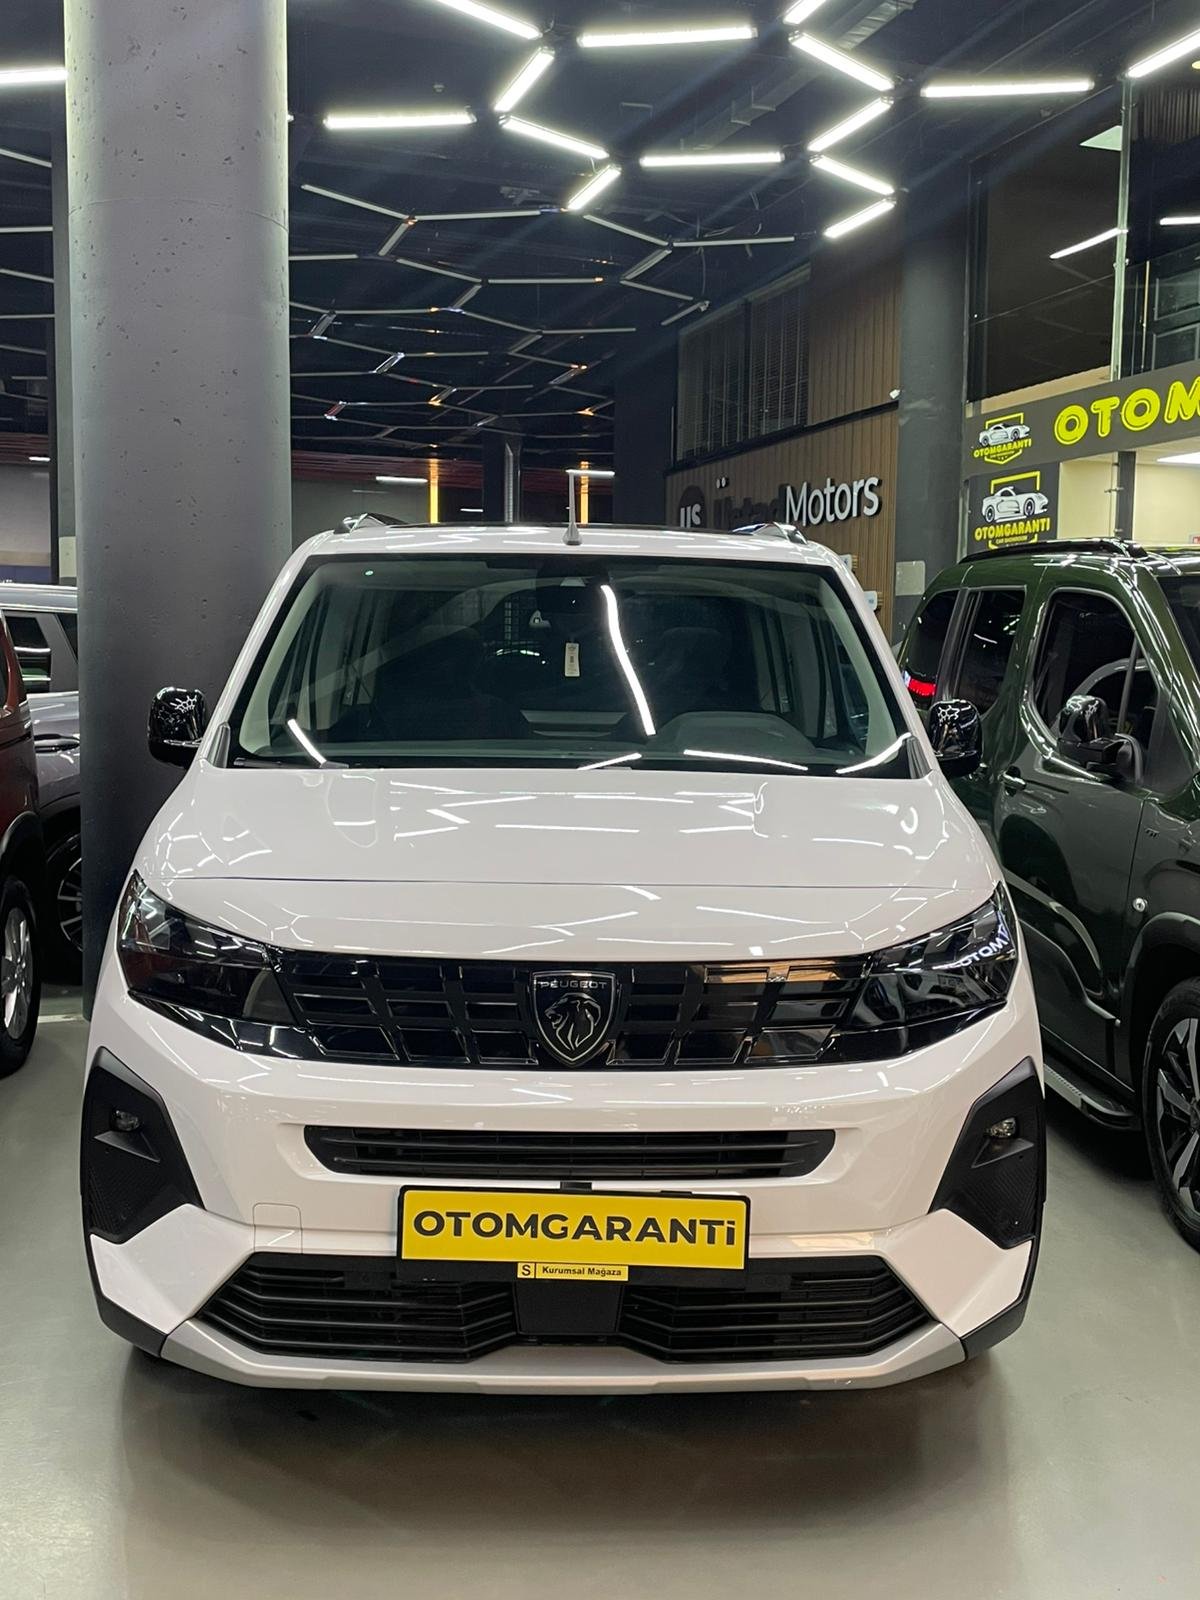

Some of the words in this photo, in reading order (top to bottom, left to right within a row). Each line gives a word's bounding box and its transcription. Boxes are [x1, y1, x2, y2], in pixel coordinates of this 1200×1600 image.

[973, 438, 1032, 458] OTOMGARANTI
[785, 477, 879, 527] Motors
[974, 517, 1051, 541] OTOMGARANTI
[537, 980, 608, 989] PEUGEOT
[521, 1264, 531, 1277] S
[542, 1266, 585, 1276] Kurumsal
[587, 1267, 622, 1278] Mağaza
